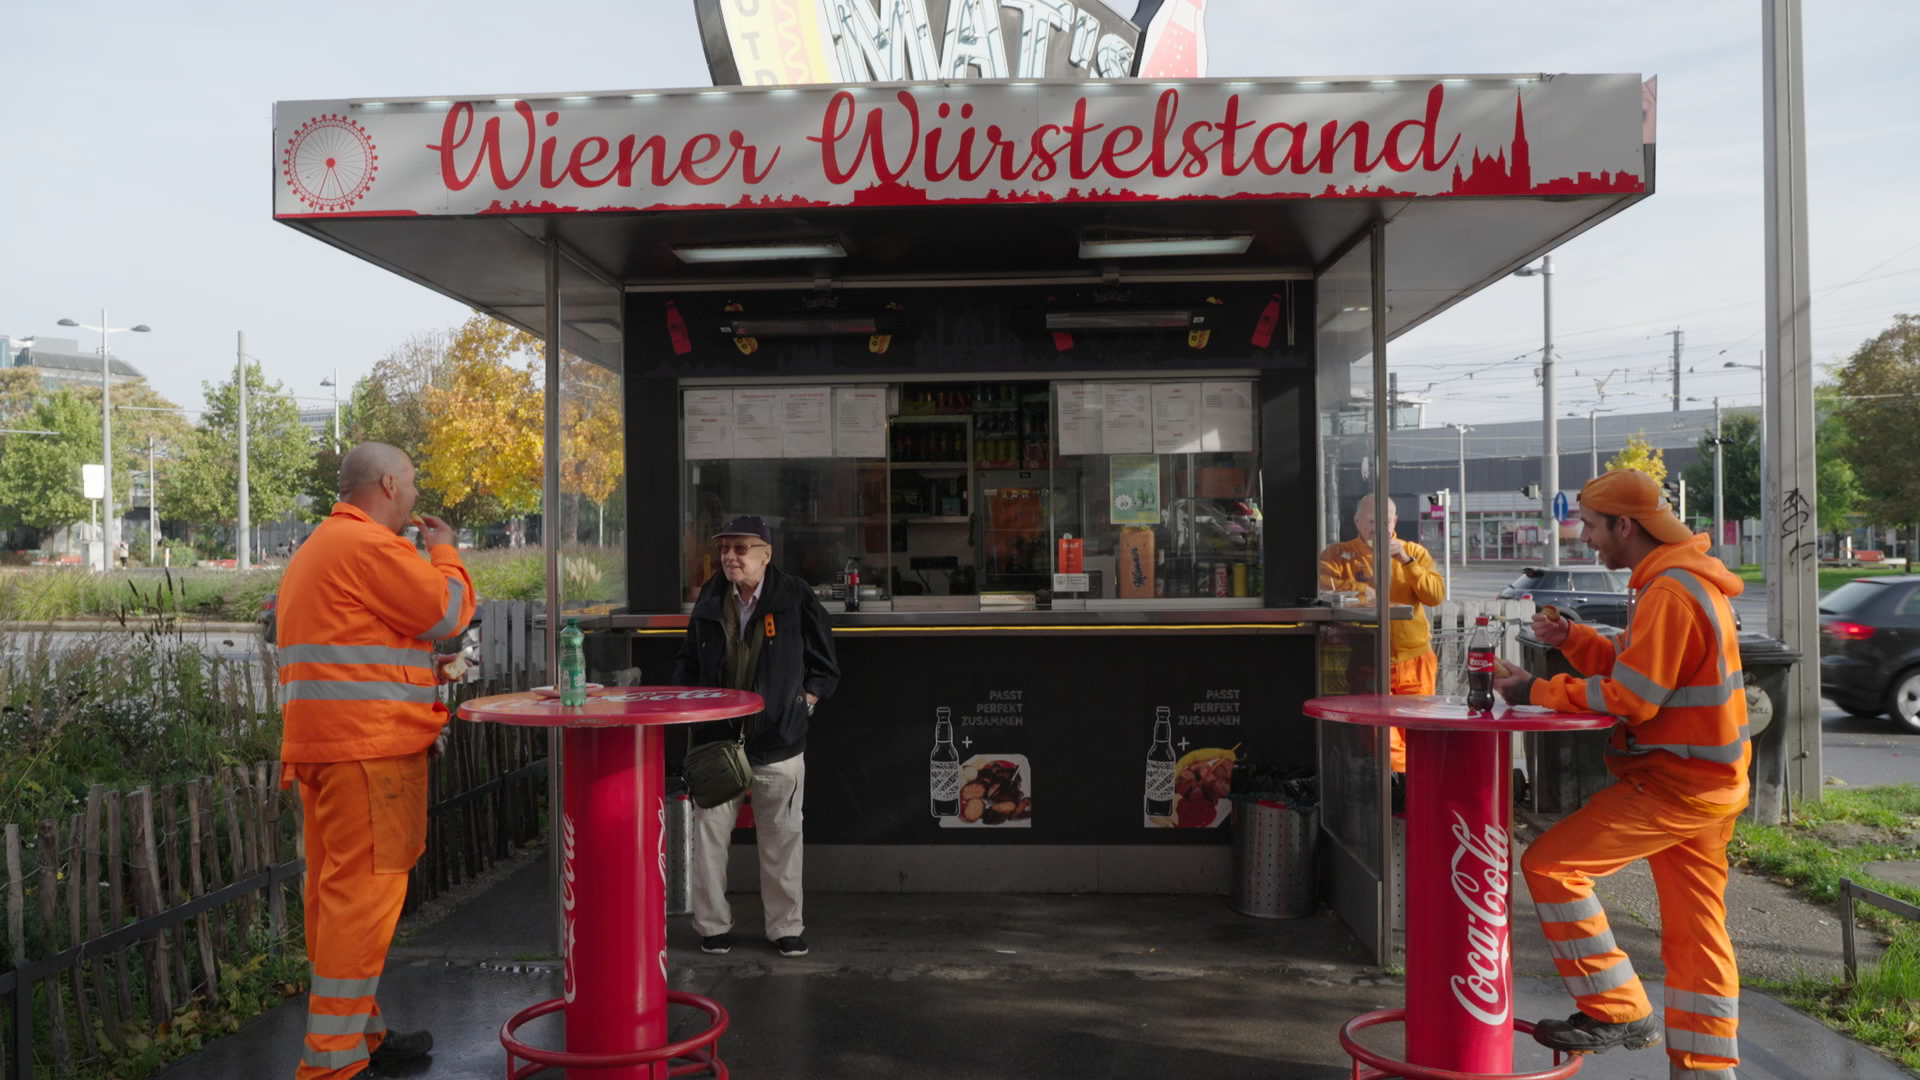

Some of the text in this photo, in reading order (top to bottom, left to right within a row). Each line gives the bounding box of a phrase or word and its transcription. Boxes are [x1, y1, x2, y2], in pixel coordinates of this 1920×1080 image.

[426, 84, 1462, 191] Wiener Würstelstand
[989, 690, 1024, 700] PASST
[1206, 689, 1240, 699] PASST
[976, 703, 1024, 713] PERFEKT
[1193, 702, 1240, 713] PERFEKT
[961, 716, 1024, 726] ZUSAMMEN
[1178, 715, 1240, 725] ZUSAMMEN
[1450, 809, 1510, 1026] Coca-Cola
